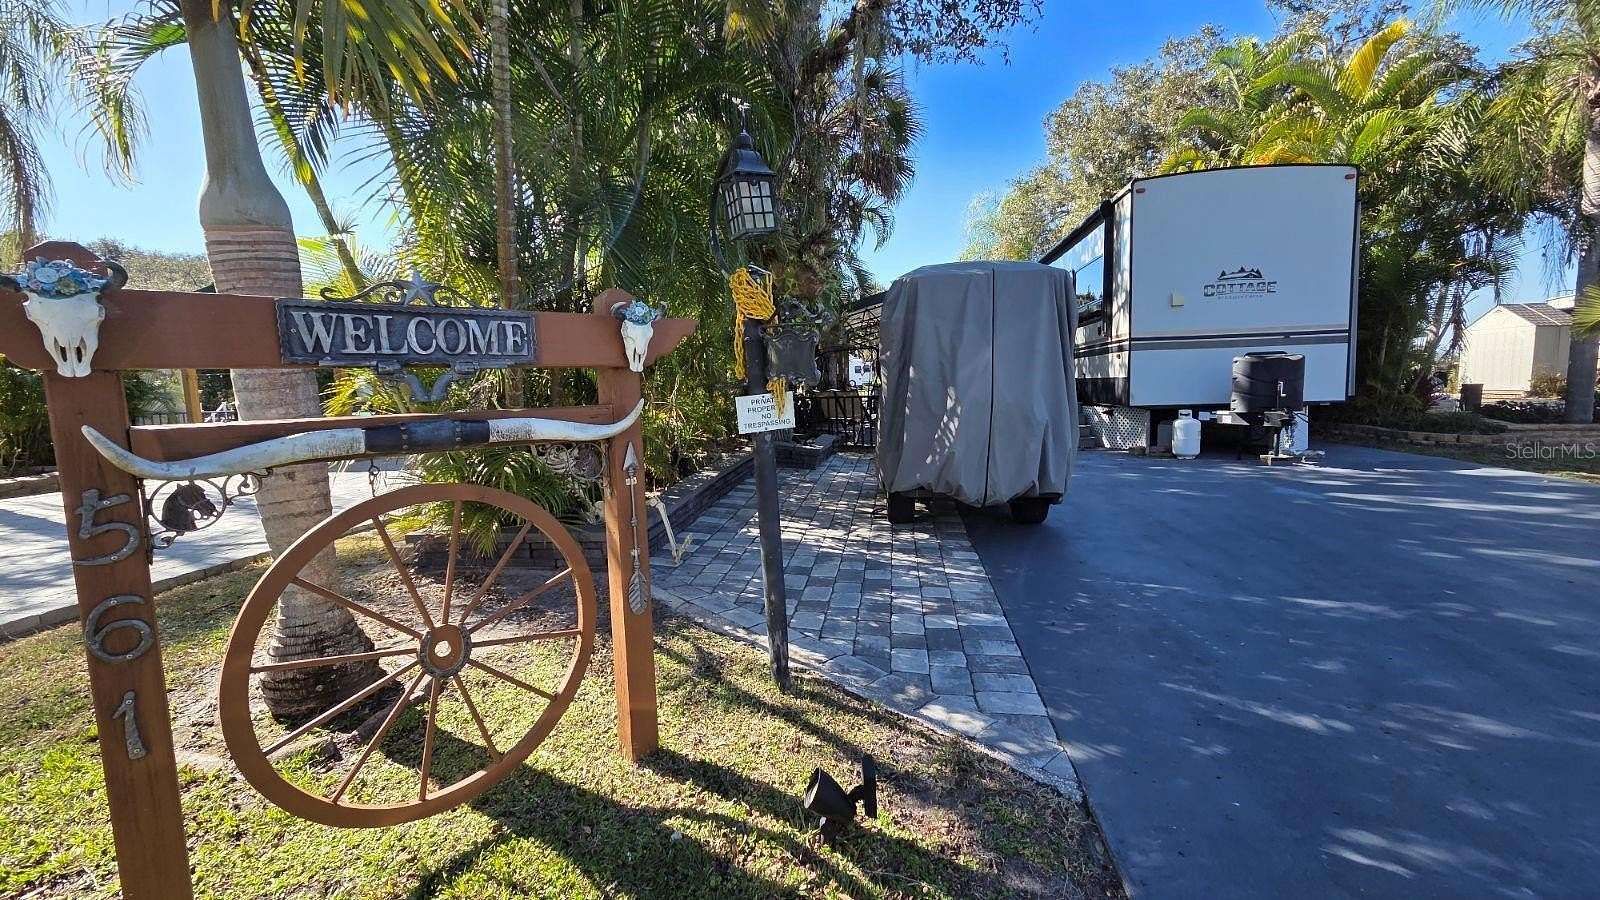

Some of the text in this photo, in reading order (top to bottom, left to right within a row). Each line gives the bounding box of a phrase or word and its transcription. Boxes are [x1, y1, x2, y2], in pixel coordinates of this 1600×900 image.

[1203, 281, 1277, 297] COTTAGE
[290, 310, 528, 356] WELCOME
[751, 397, 775, 406] PRIVAT
[747, 405, 776, 413] PROPER
[743, 418, 792, 430] TRESPASSING
